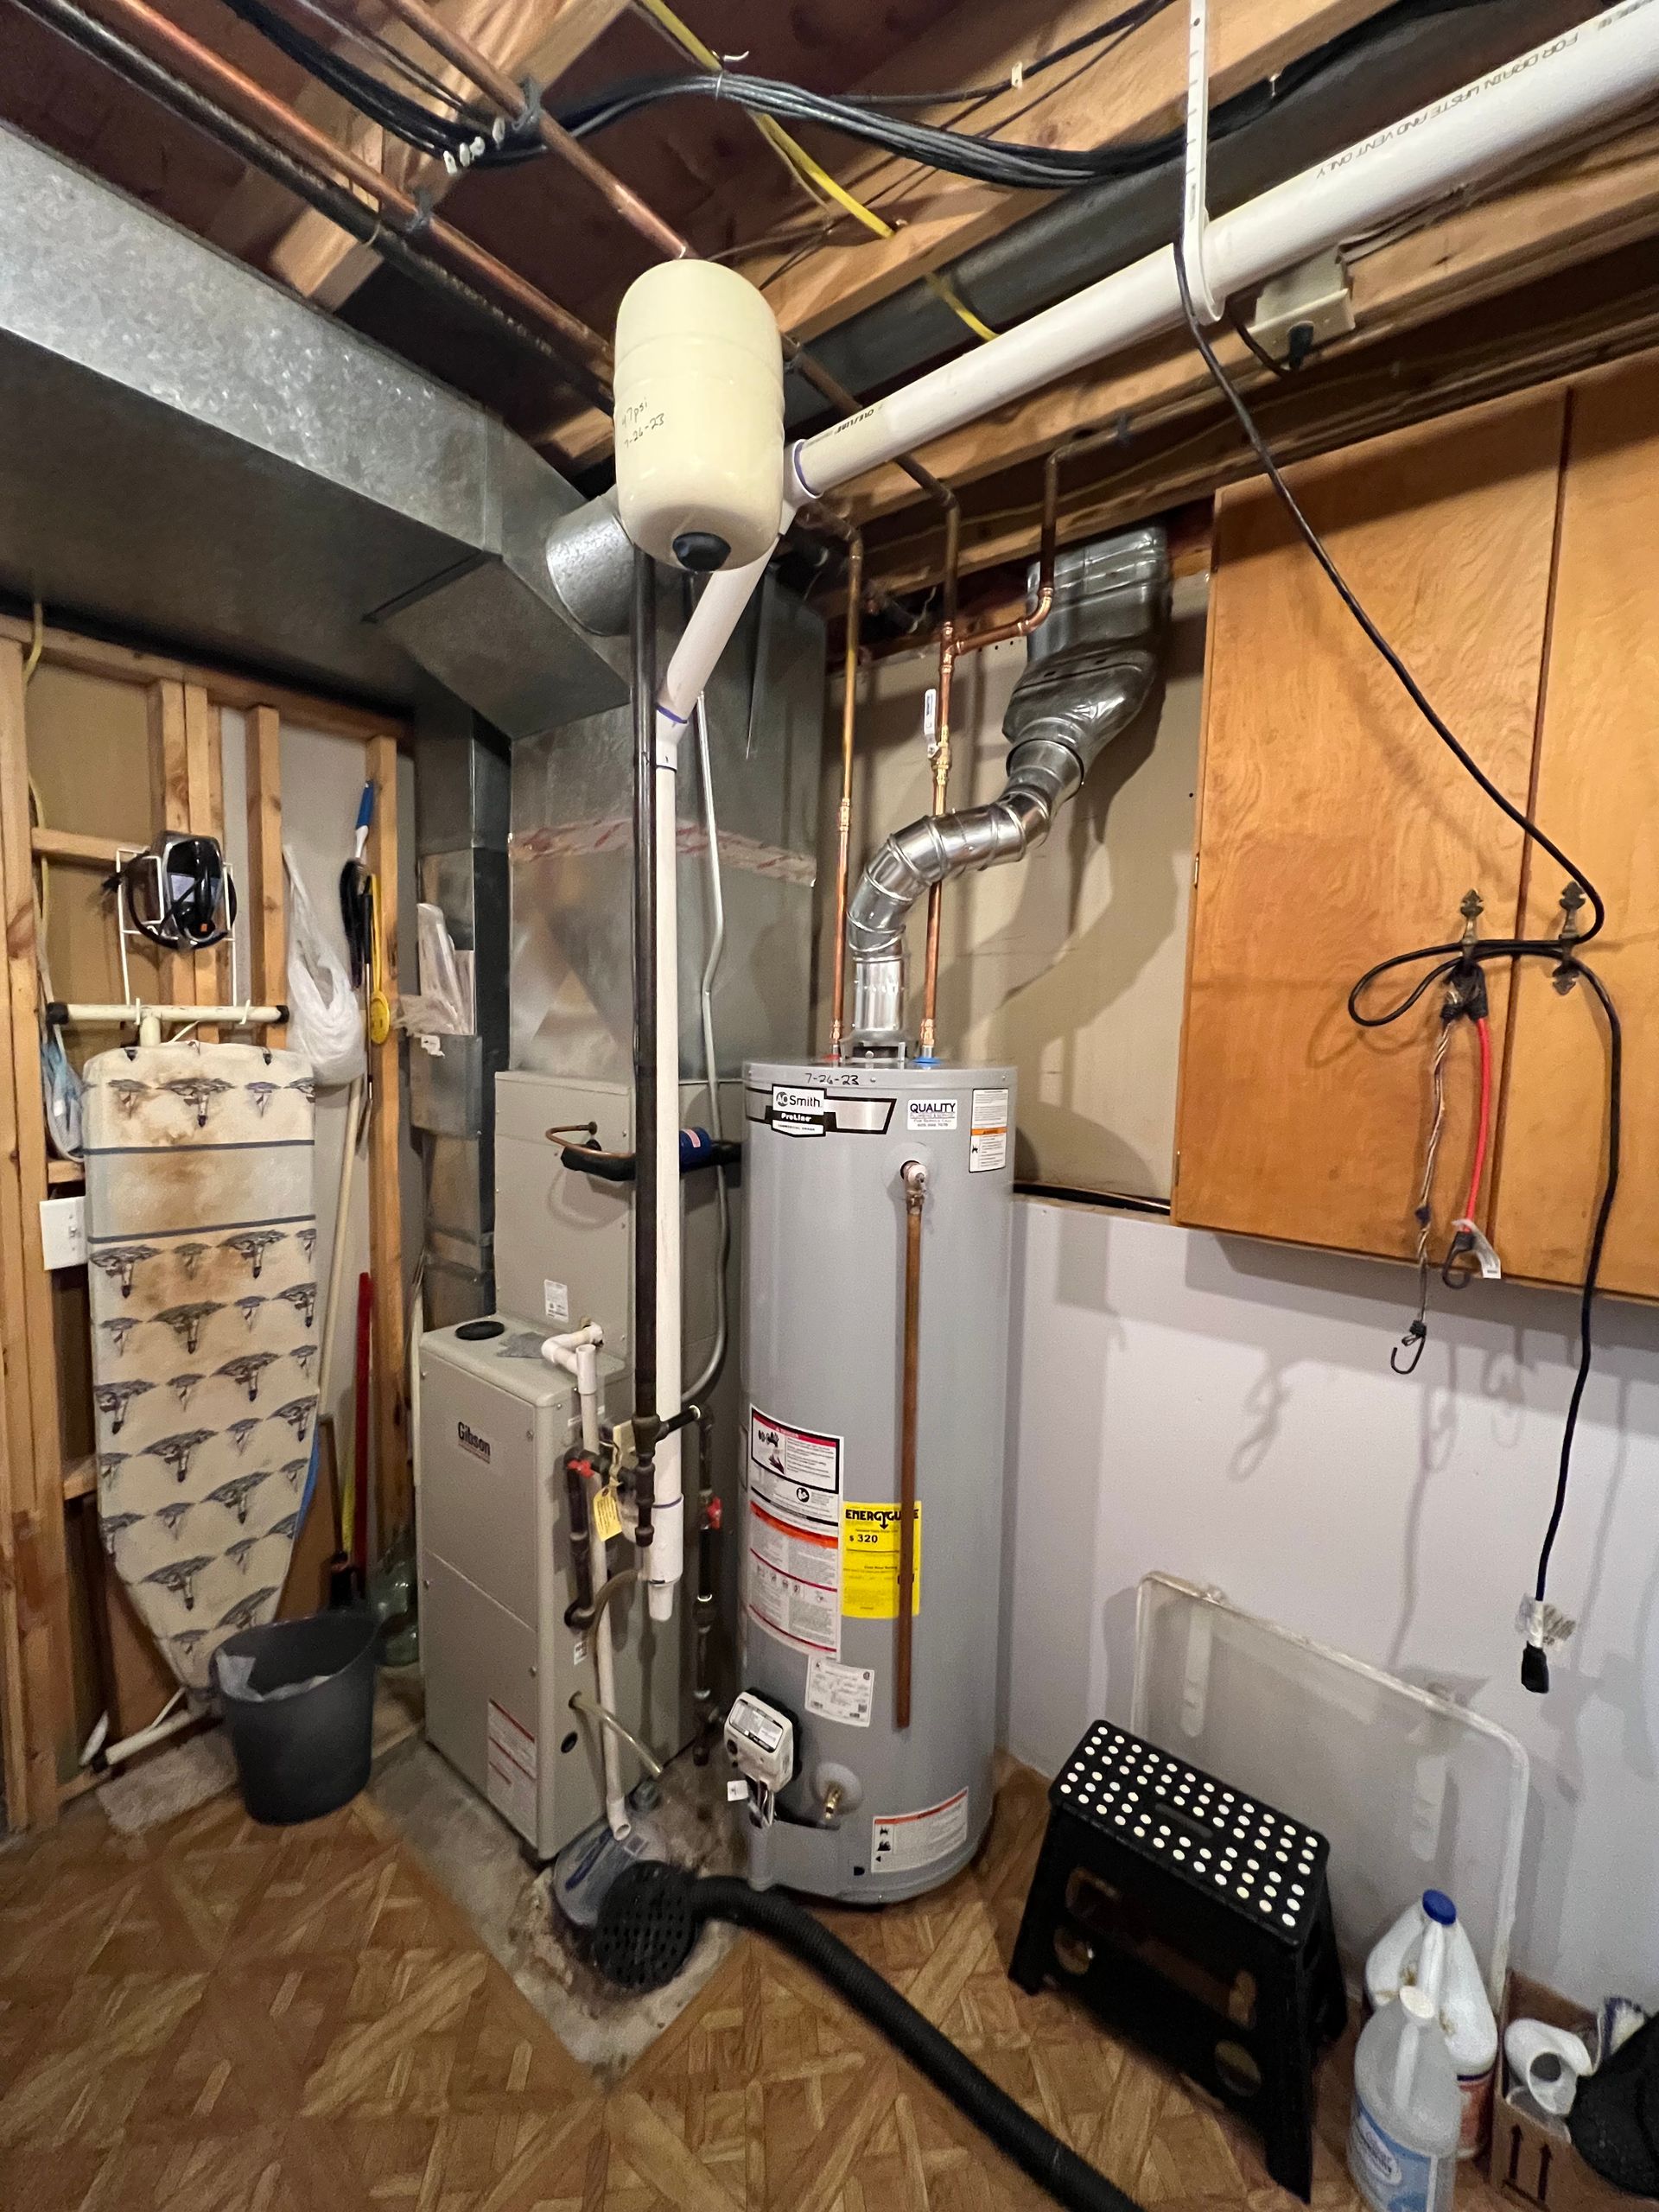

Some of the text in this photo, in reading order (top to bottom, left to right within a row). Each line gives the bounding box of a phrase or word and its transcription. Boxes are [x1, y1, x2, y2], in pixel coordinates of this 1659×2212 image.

[1542, 31, 1580, 60] FOR
[1483, 54, 1540, 90] DRAIN
[1395, 111, 1429, 136] AND
[1356, 130, 1394, 157] VENT
[1316, 150, 1354, 179] ONLY
[624, 412, 664, 448] 7-26-23
[804, 1072, 860, 1086] 7-26-23
[789, 1095, 821, 1108] Smith
[910, 1103, 956, 1114] QUALITY
[780, 1112, 812, 1122] ProLine
[458, 1421, 491, 1457] Gibson
[857, 1534, 878, 1543] 320
